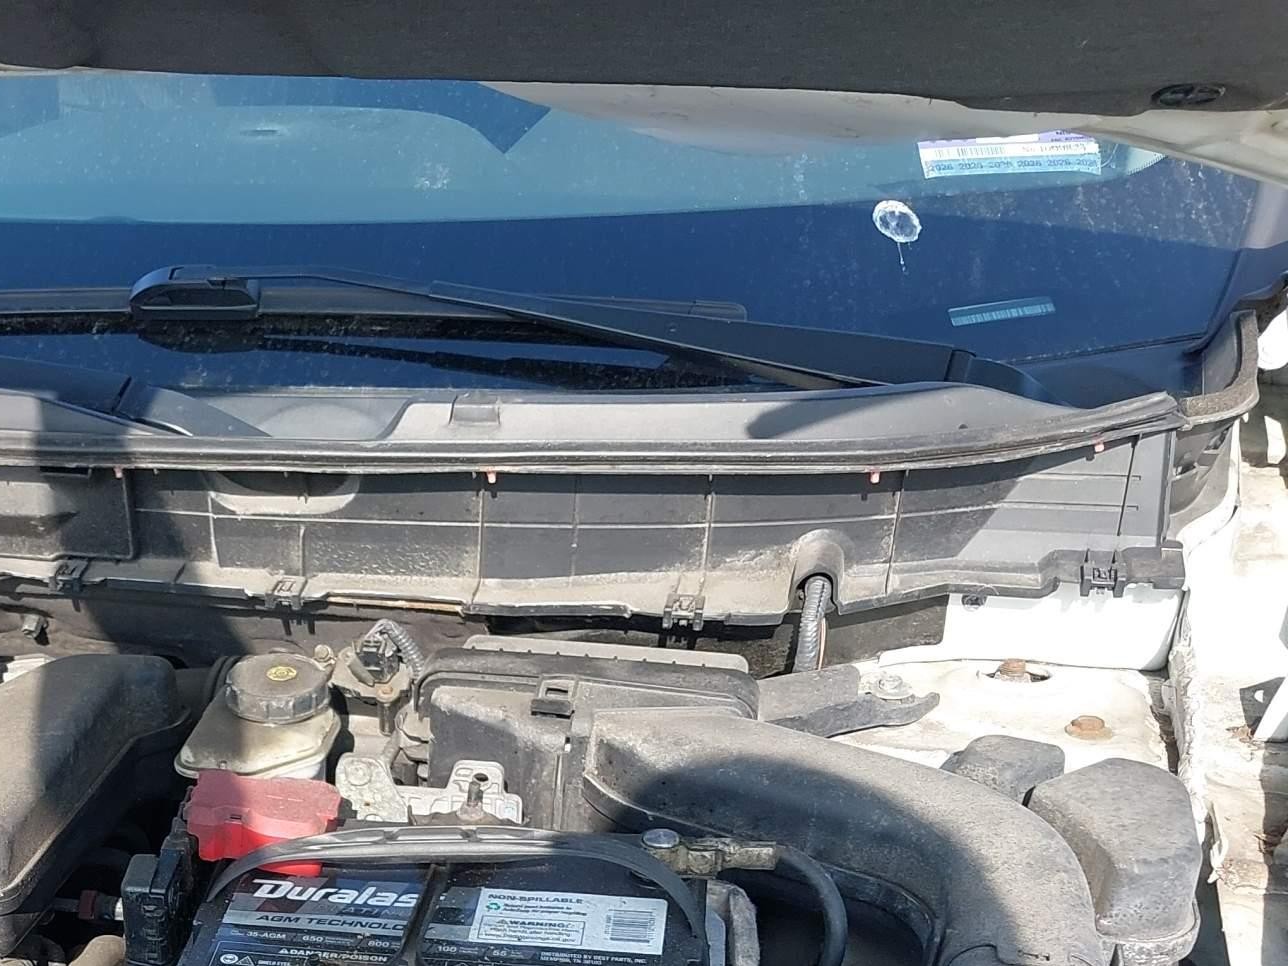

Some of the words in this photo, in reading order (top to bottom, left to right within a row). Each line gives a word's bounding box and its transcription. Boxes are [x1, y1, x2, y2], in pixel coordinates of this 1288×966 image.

[252, 878, 420, 908] Duralas
[487, 893, 585, 905] NON-SPILLABLE
[255, 913, 301, 924] AGM
[246, 931, 287, 939] 35-AGM
[367, 940, 390, 948] 800
